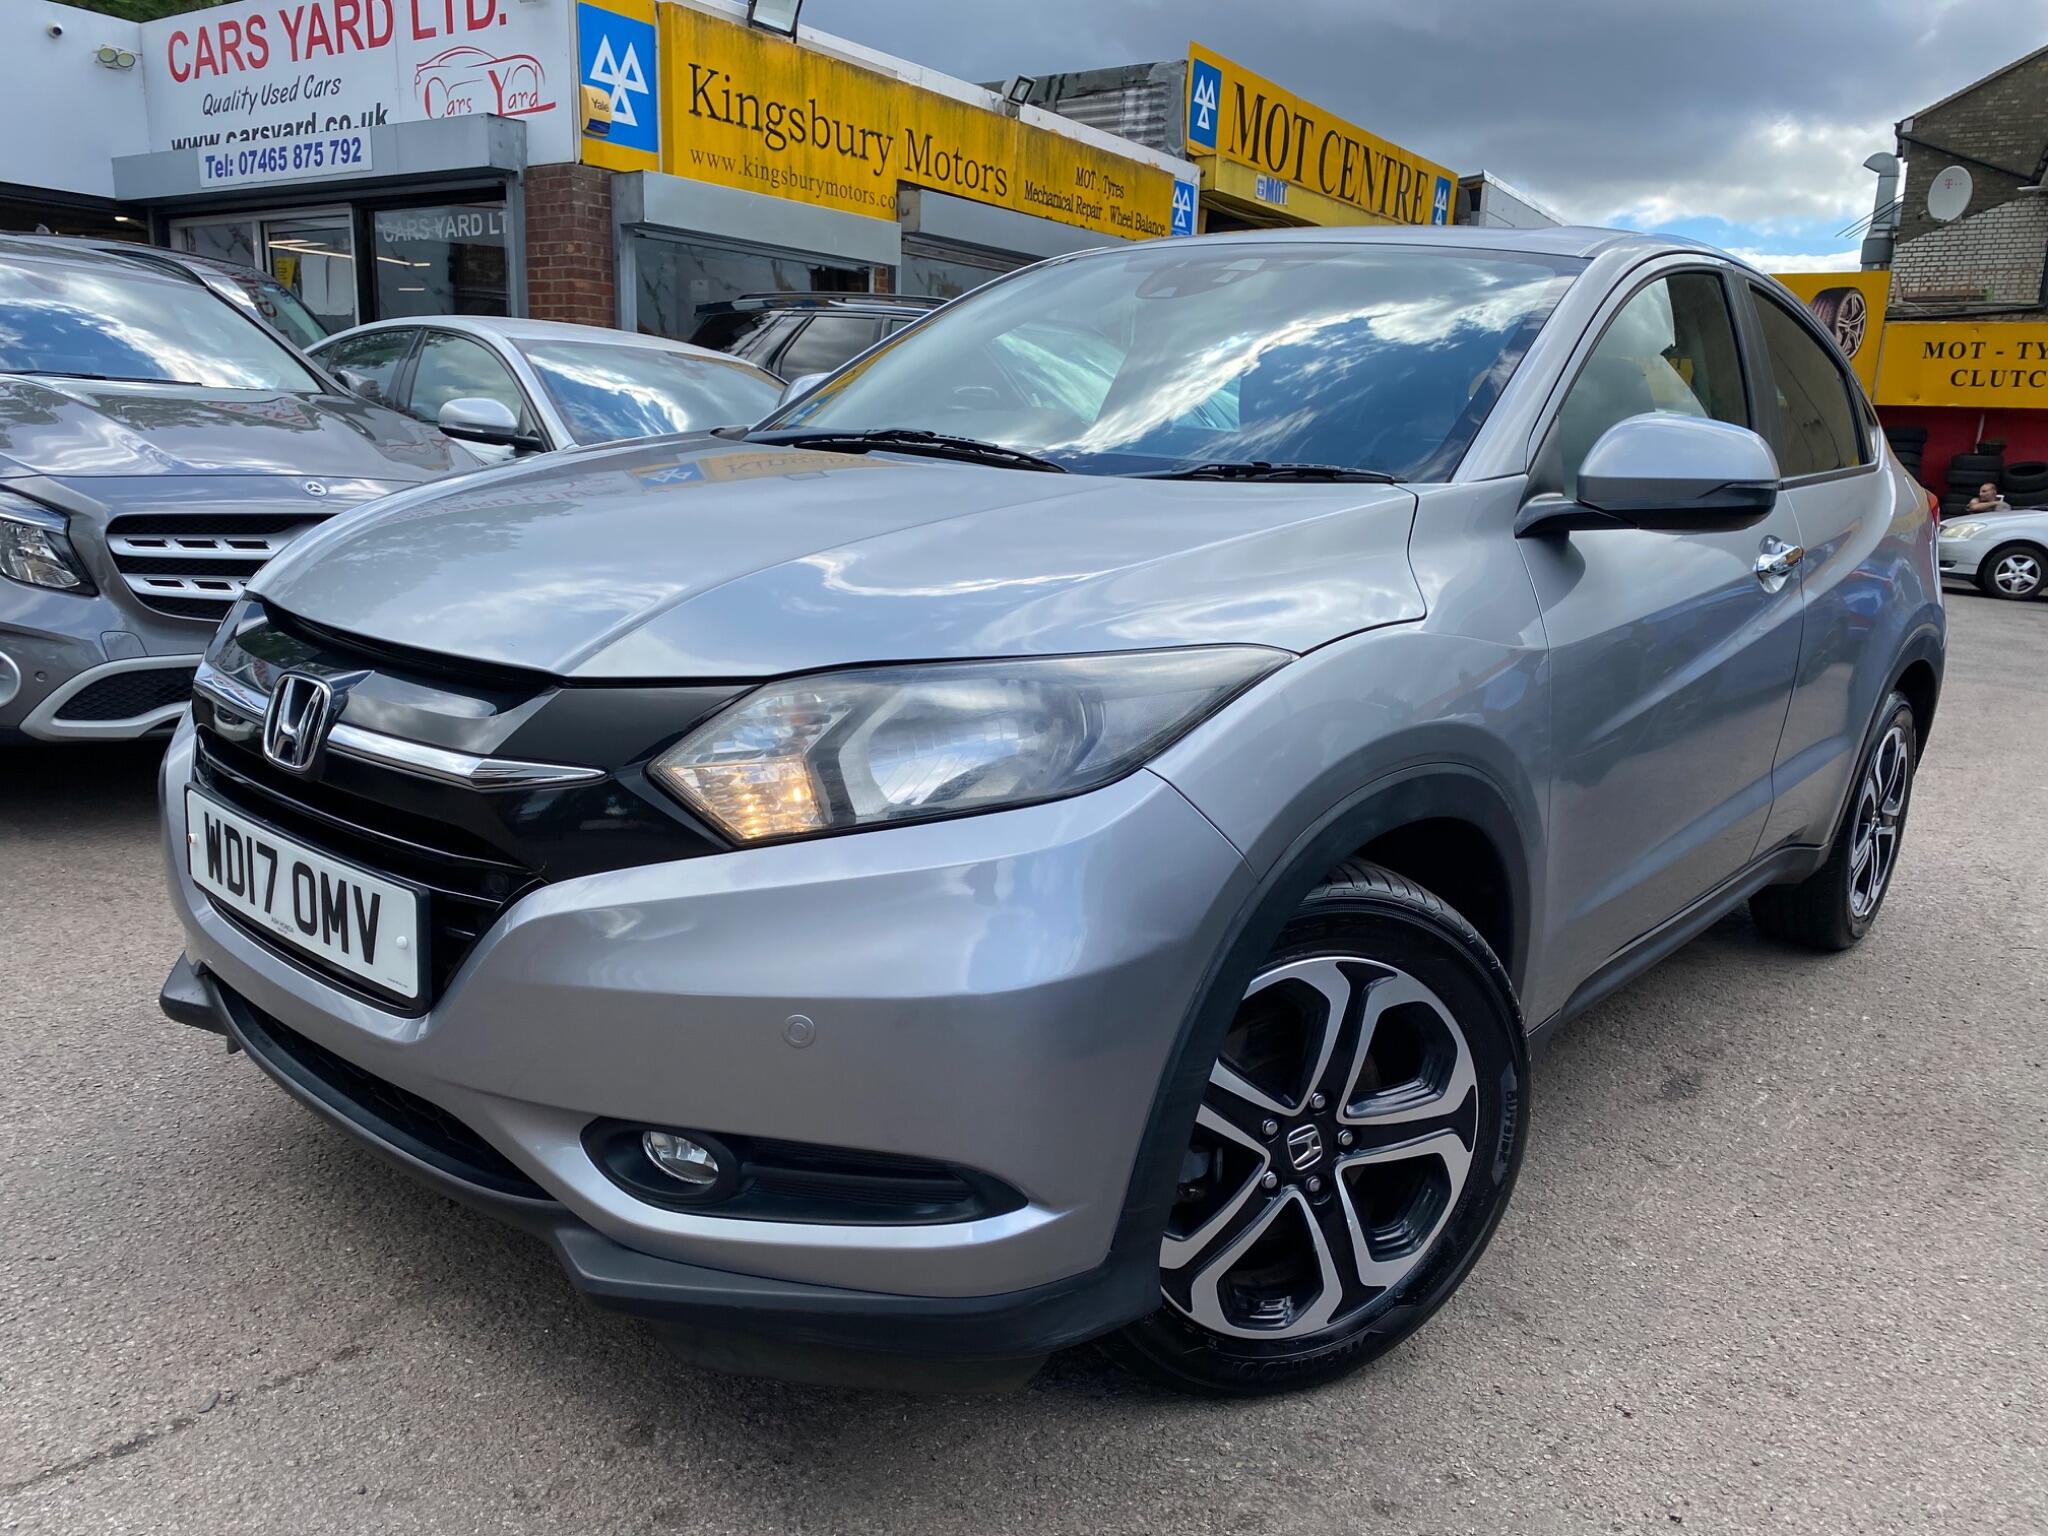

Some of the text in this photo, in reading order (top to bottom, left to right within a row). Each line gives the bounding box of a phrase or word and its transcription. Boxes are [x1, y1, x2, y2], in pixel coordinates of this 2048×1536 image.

[168, 14, 269, 83] CARS
[278, 0, 394, 62] YARD
[202, 74, 342, 116] Quality Used Cars
[591, 97, 610, 113] Yale
[170, 102, 389, 151] wwwcarsyard.co.uk
[687, 63, 1008, 197] Kingsbury Motors
[205, 136, 362, 179] Tel: 07465 875 792
[1227, 81, 1429, 225] MOT CENTRE
[690, 148, 896, 210] www.kingsburymotors.co
[1075, 166, 1096, 191] MOT
[1103, 175, 1125, 200] Tyres
[383, 218, 431, 242] CARS
[433, 212, 483, 239] YARD
[1024, 180, 1074, 213] Mechanical
[1076, 195, 1103, 222] Repair
[1110, 204, 1134, 230] Wheel
[1135, 214, 1166, 237] Balance
[1922, 341, 1987, 360] MOT
[2016, 341, 2048, 360] TY
[1950, 368, 2048, 389] CLUTC
[203, 811, 381, 965] WD17 OMV
